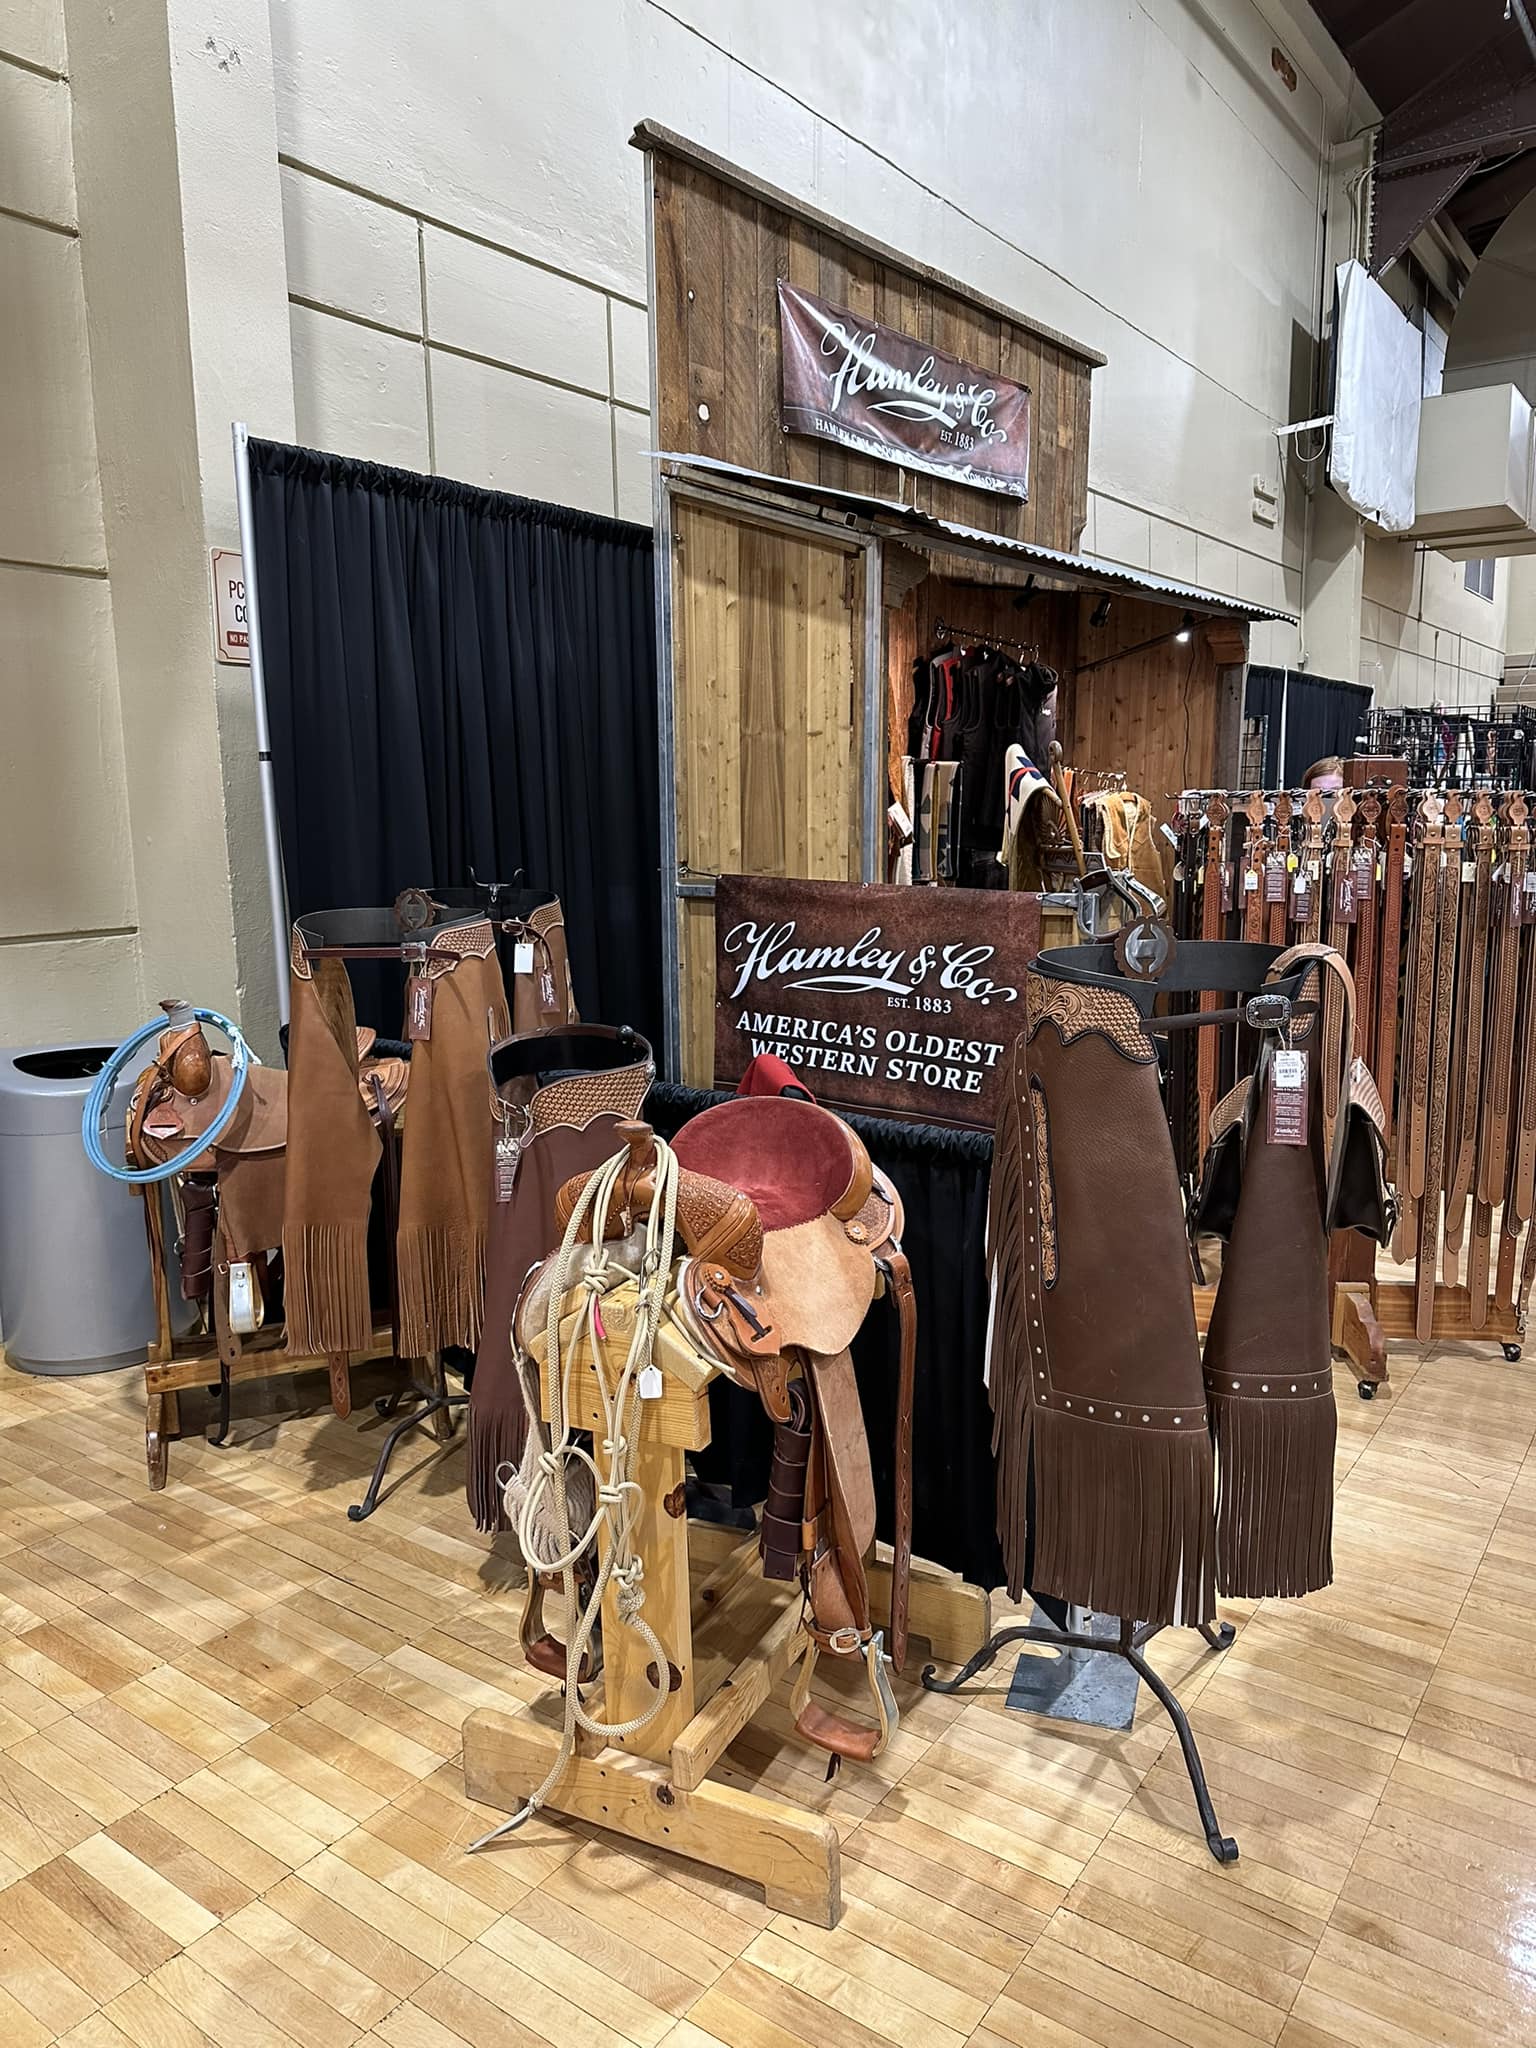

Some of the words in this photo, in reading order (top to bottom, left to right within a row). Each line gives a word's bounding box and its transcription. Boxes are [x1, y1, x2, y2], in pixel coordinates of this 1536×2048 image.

[821, 322, 958, 429] Hamley
[953, 382, 968, 419] &
[940, 429, 953, 444] EST.
[954, 431, 976, 451] 1883
[724, 920, 916, 1000] Hamley
[908, 945, 937, 985] &
[940, 942, 1018, 1006] Co.
[887, 996, 911, 1009] EST.
[914, 996, 952, 1014] 1883
[736, 1010, 877, 1049] AMERICA'S
[885, 1030, 1004, 1067] OLDEST
[750, 1038, 879, 1077] WESTERN
[886, 1058, 983, 1094] STORE
